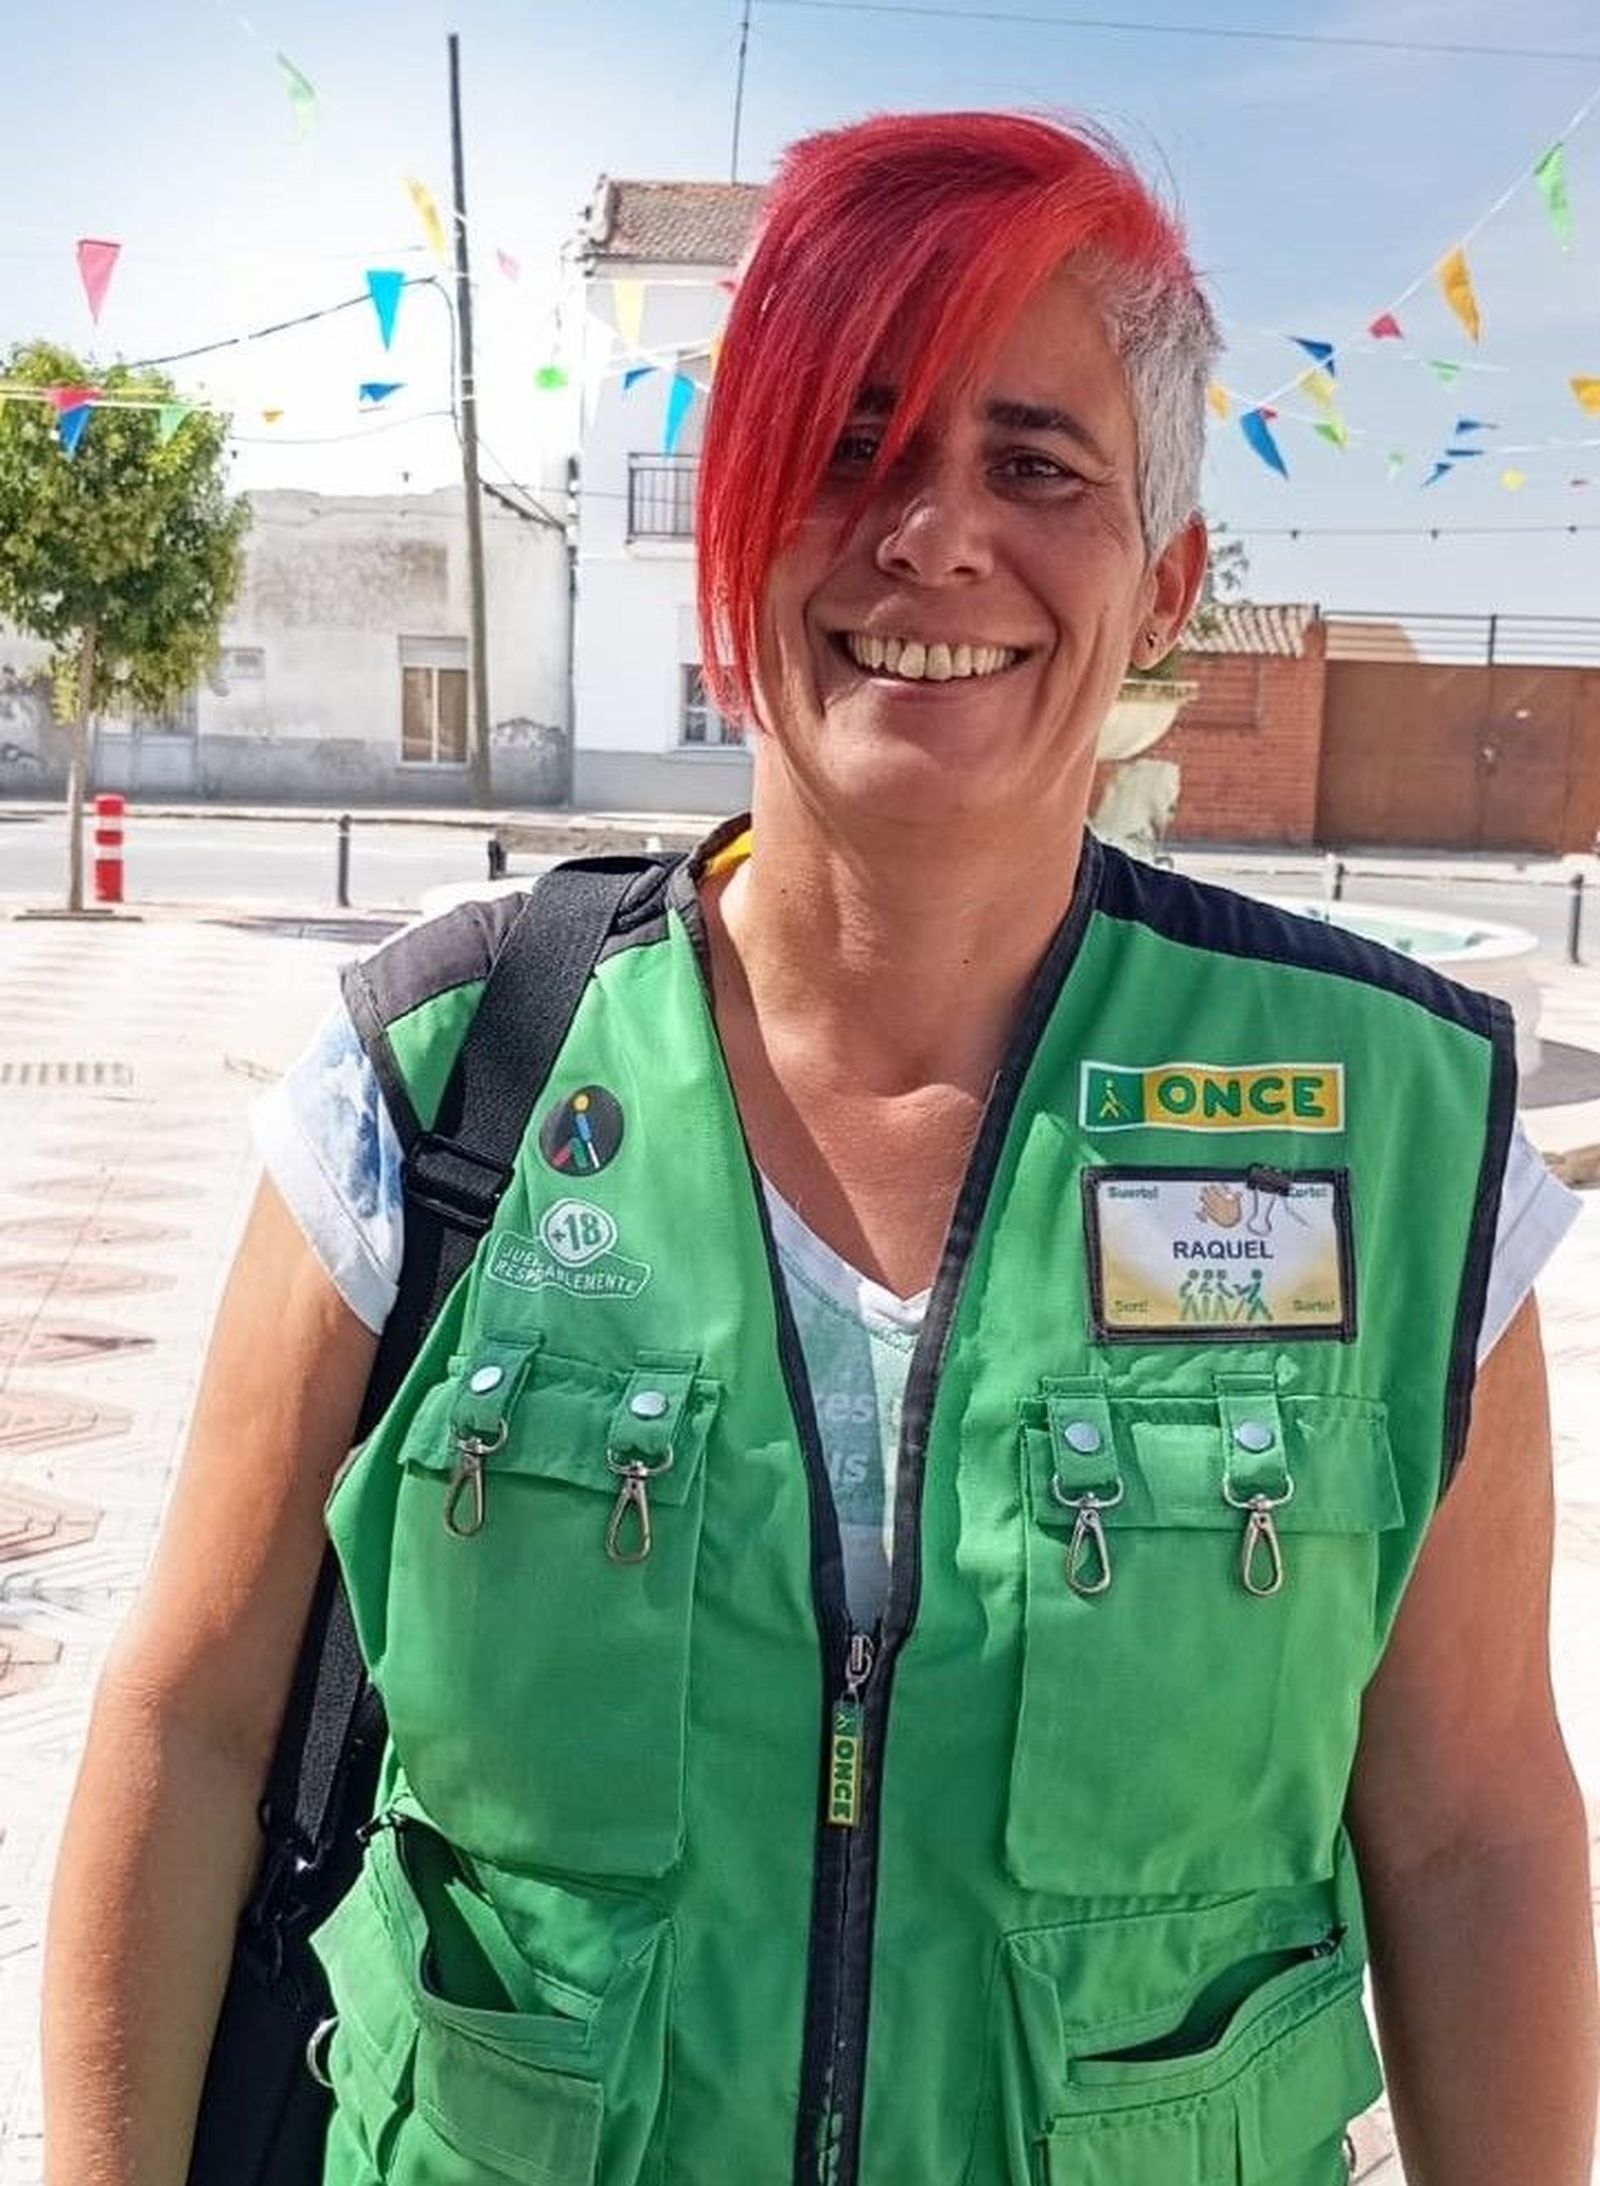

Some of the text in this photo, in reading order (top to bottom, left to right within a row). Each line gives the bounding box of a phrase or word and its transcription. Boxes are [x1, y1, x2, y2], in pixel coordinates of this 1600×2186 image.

[1157, 1075, 1326, 1118] ONCE
[551, 1212, 601, 1251] +18
[1173, 1240, 1274, 1260] RAQUEL
[833, 1740, 856, 1819] ONCE
